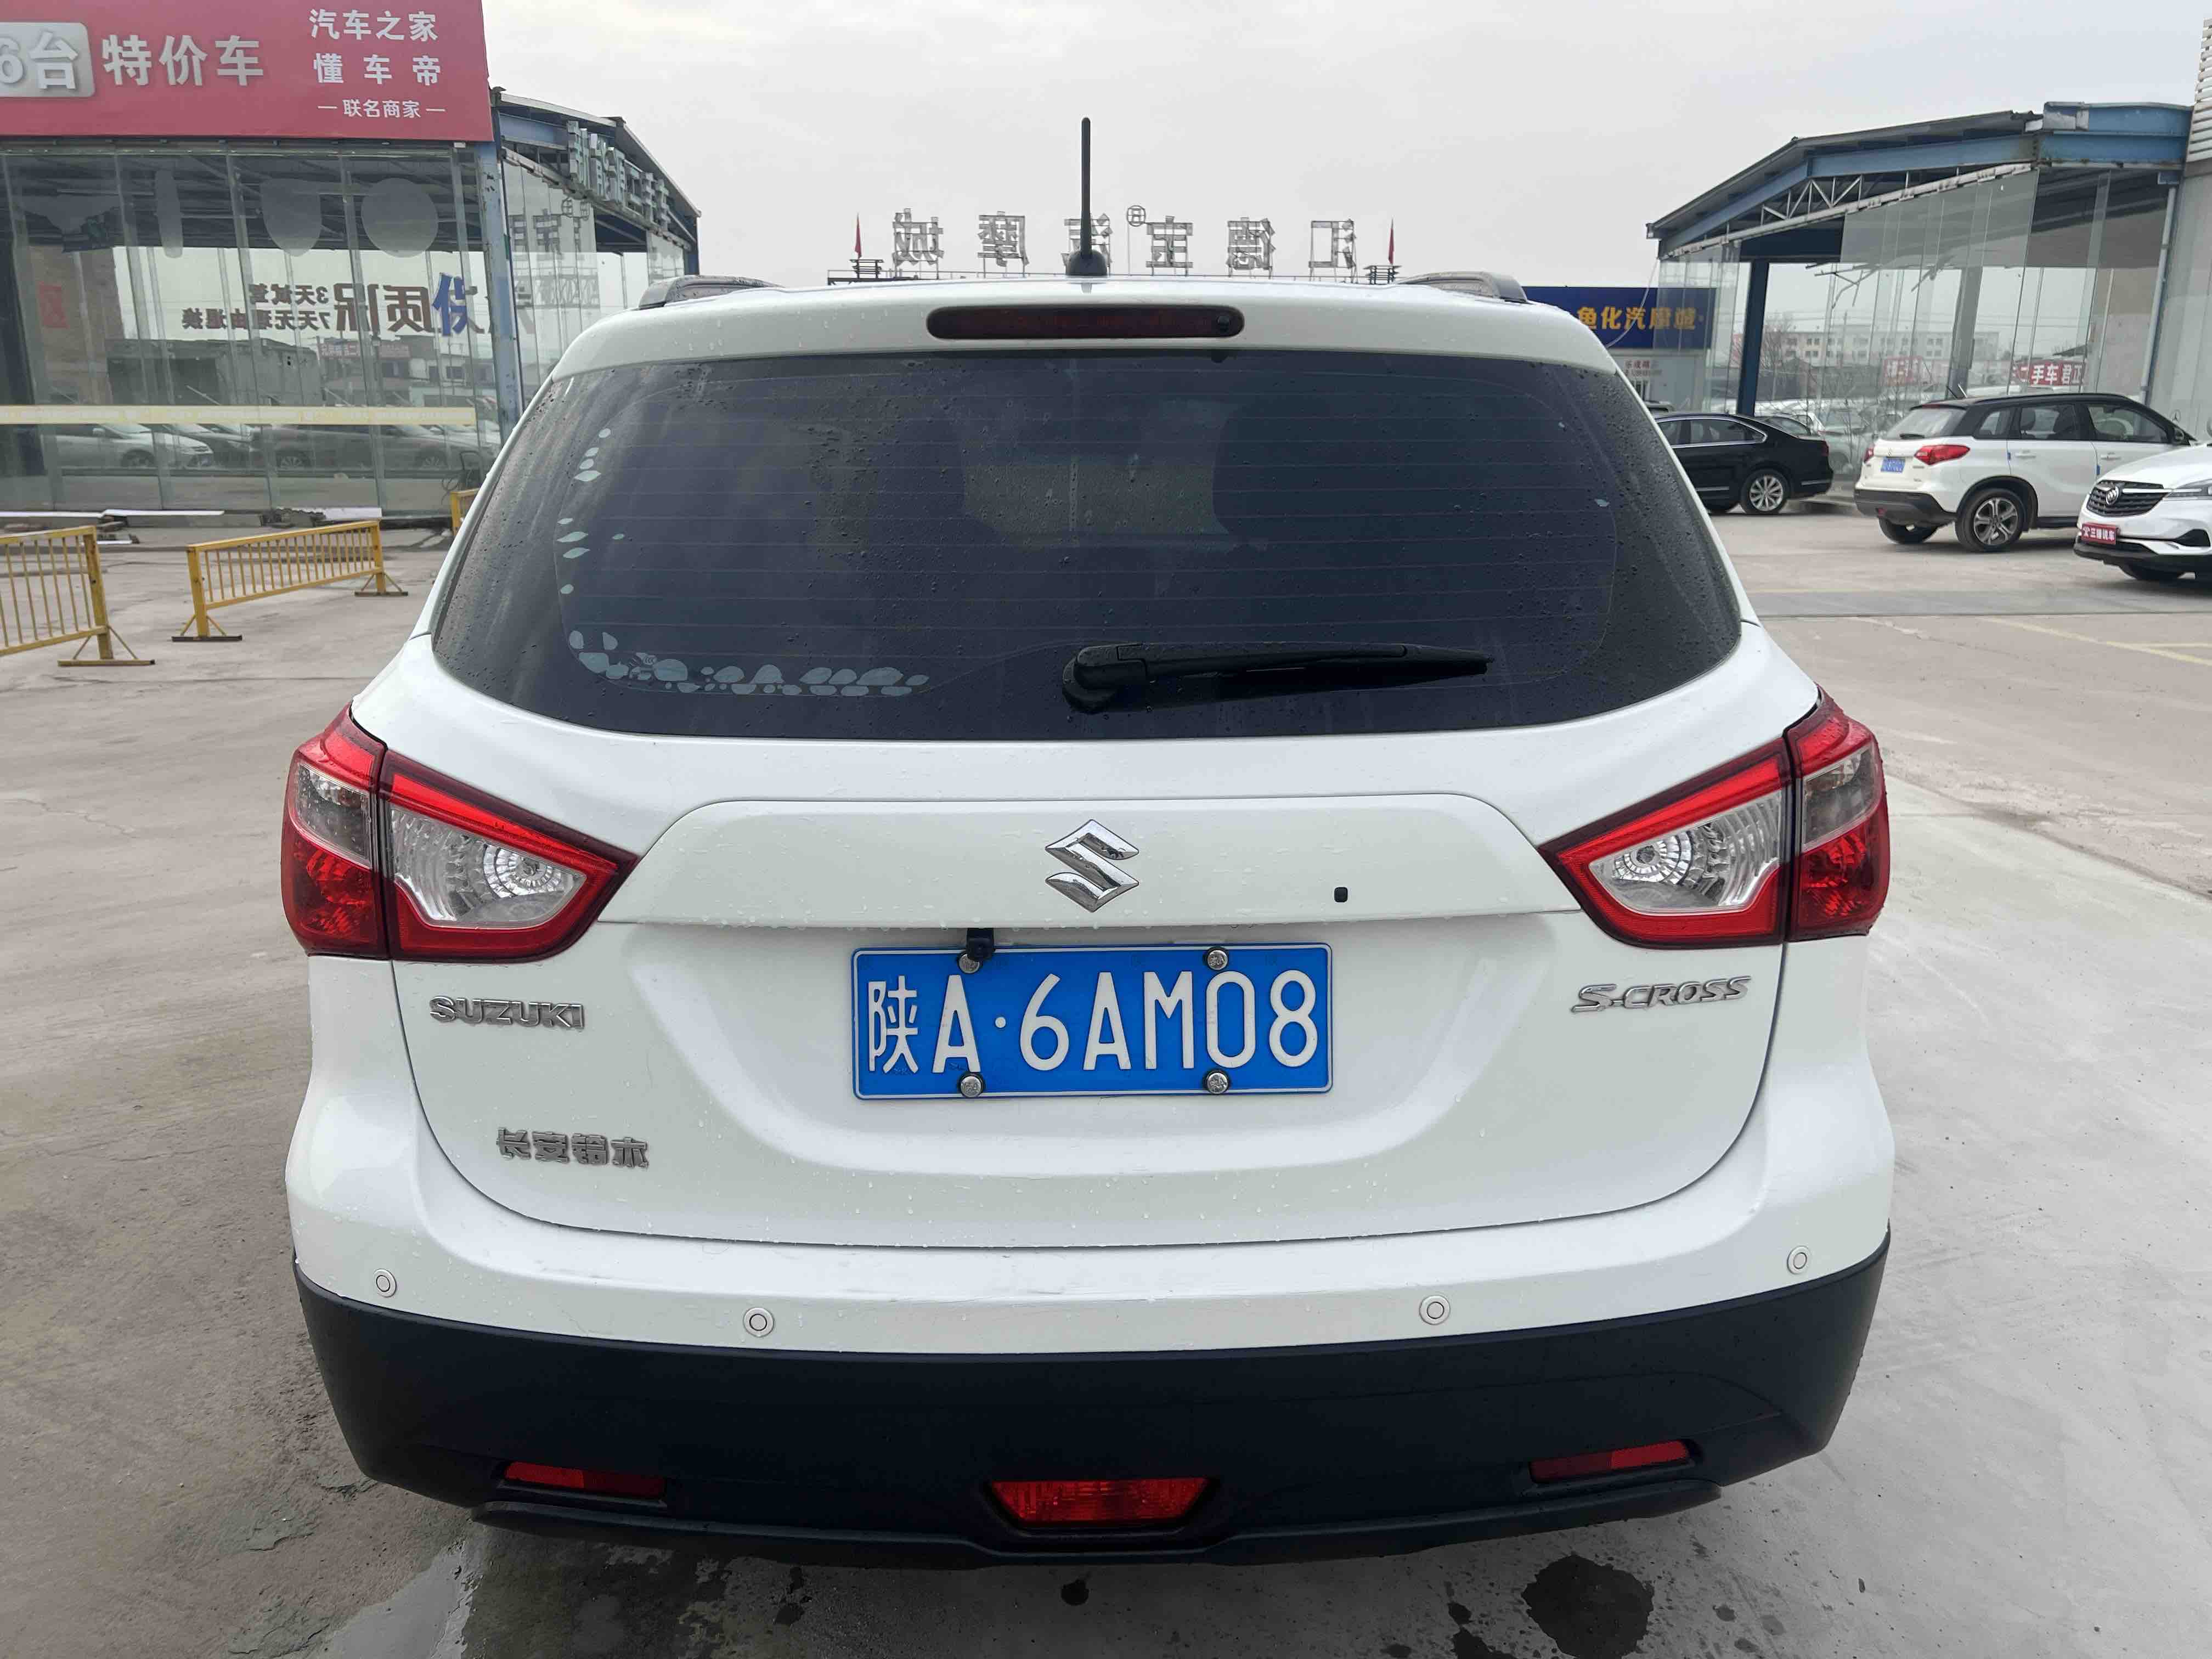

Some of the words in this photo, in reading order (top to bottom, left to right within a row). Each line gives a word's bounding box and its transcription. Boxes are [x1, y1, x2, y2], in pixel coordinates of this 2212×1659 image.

[309, 9, 439, 42] 汽车之家
[313, 53, 441, 86] 懂车帝
[343, 99, 421, 119] 联名商家
[1571, 975, 1751, 1013] S-CROSS
[430, 996, 584, 1030] SUZUKI
[867, 969, 1318, 1075] 陕A·6AM08
[495, 1127, 650, 1169] 长安铃木
